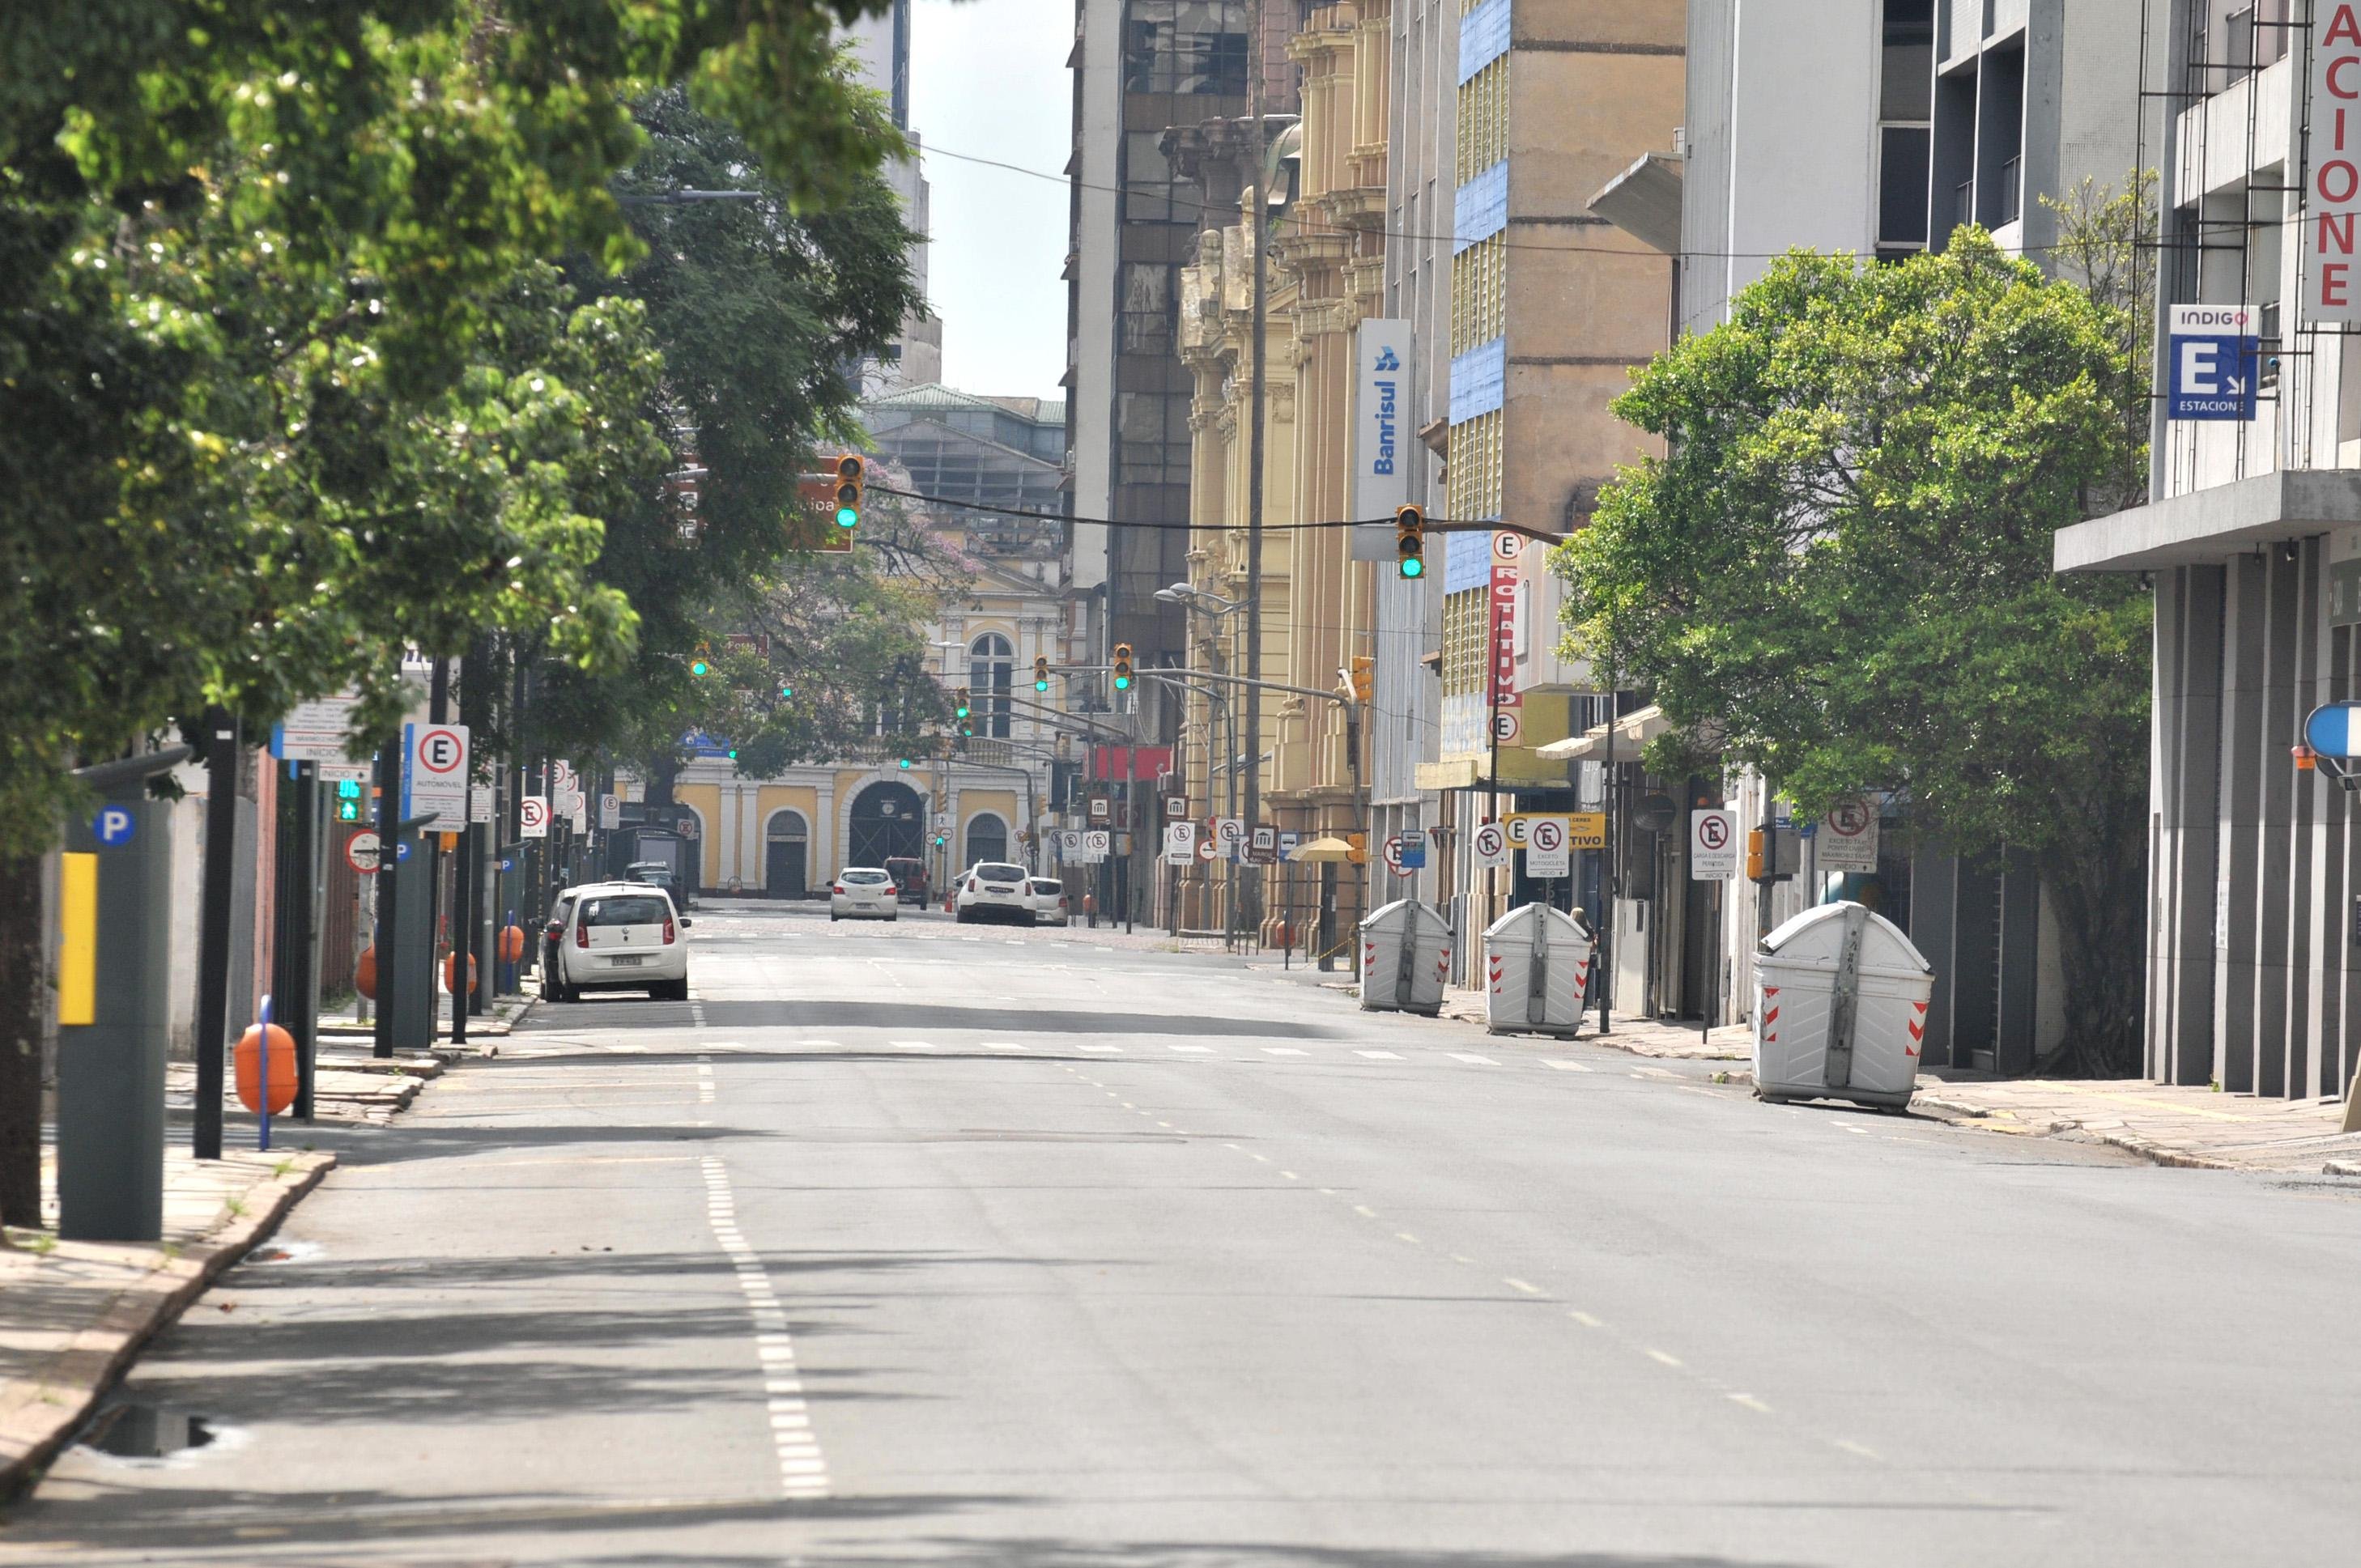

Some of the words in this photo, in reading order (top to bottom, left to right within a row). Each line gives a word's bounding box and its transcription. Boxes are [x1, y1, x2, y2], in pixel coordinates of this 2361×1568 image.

[2181, 312, 2248, 325] INDIGO
[2180, 342, 2218, 393] E
[1374, 381, 1395, 475] Banrisul
[433, 740, 449, 763] E
[103, 811, 129, 841] P
[1569, 836, 1602, 846] TIVO
